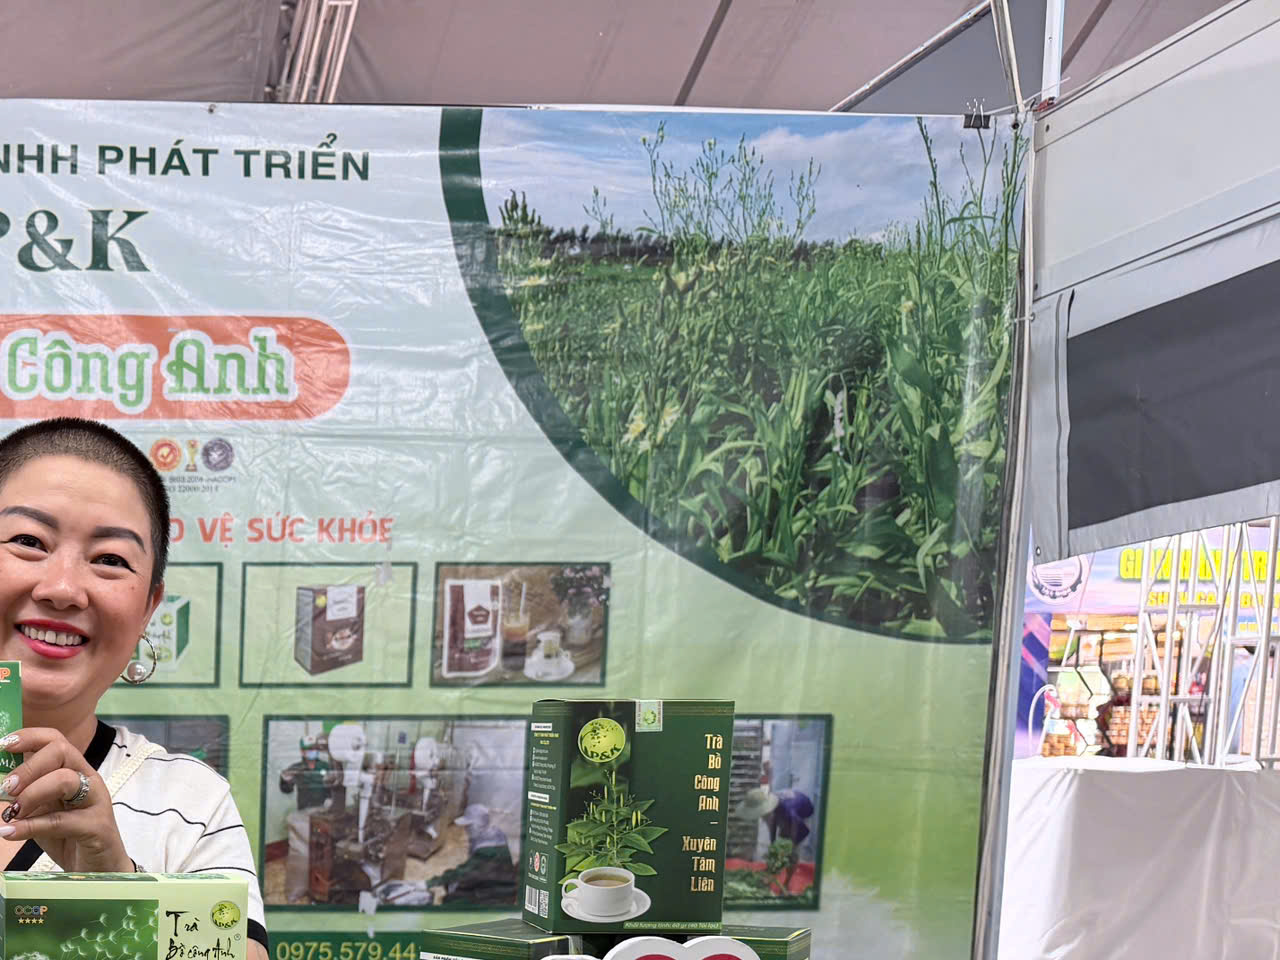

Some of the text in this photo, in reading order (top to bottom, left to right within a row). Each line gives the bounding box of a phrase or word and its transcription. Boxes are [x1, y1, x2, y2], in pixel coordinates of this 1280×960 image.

[98, 139, 219, 179] PHÁT
[235, 132, 371, 181] TRIỂN
[6, 332, 150, 408] Công
[166, 334, 289, 396] Anh
[197, 510, 394, 548] VỆ SỨC KHỎE
[705, 734, 722, 749] Trà
[589, 744, 621, 761] P&K
[708, 754, 721, 769] Bồ
[694, 774, 720, 792] Công
[698, 795, 718, 811] Anh
[682, 836, 716, 853] Xuyên
[692, 856, 715, 872] Tâm
[691, 876, 714, 892] Liên
[15, 905, 48, 917] OCOP
[166, 910, 200, 937] Trà
